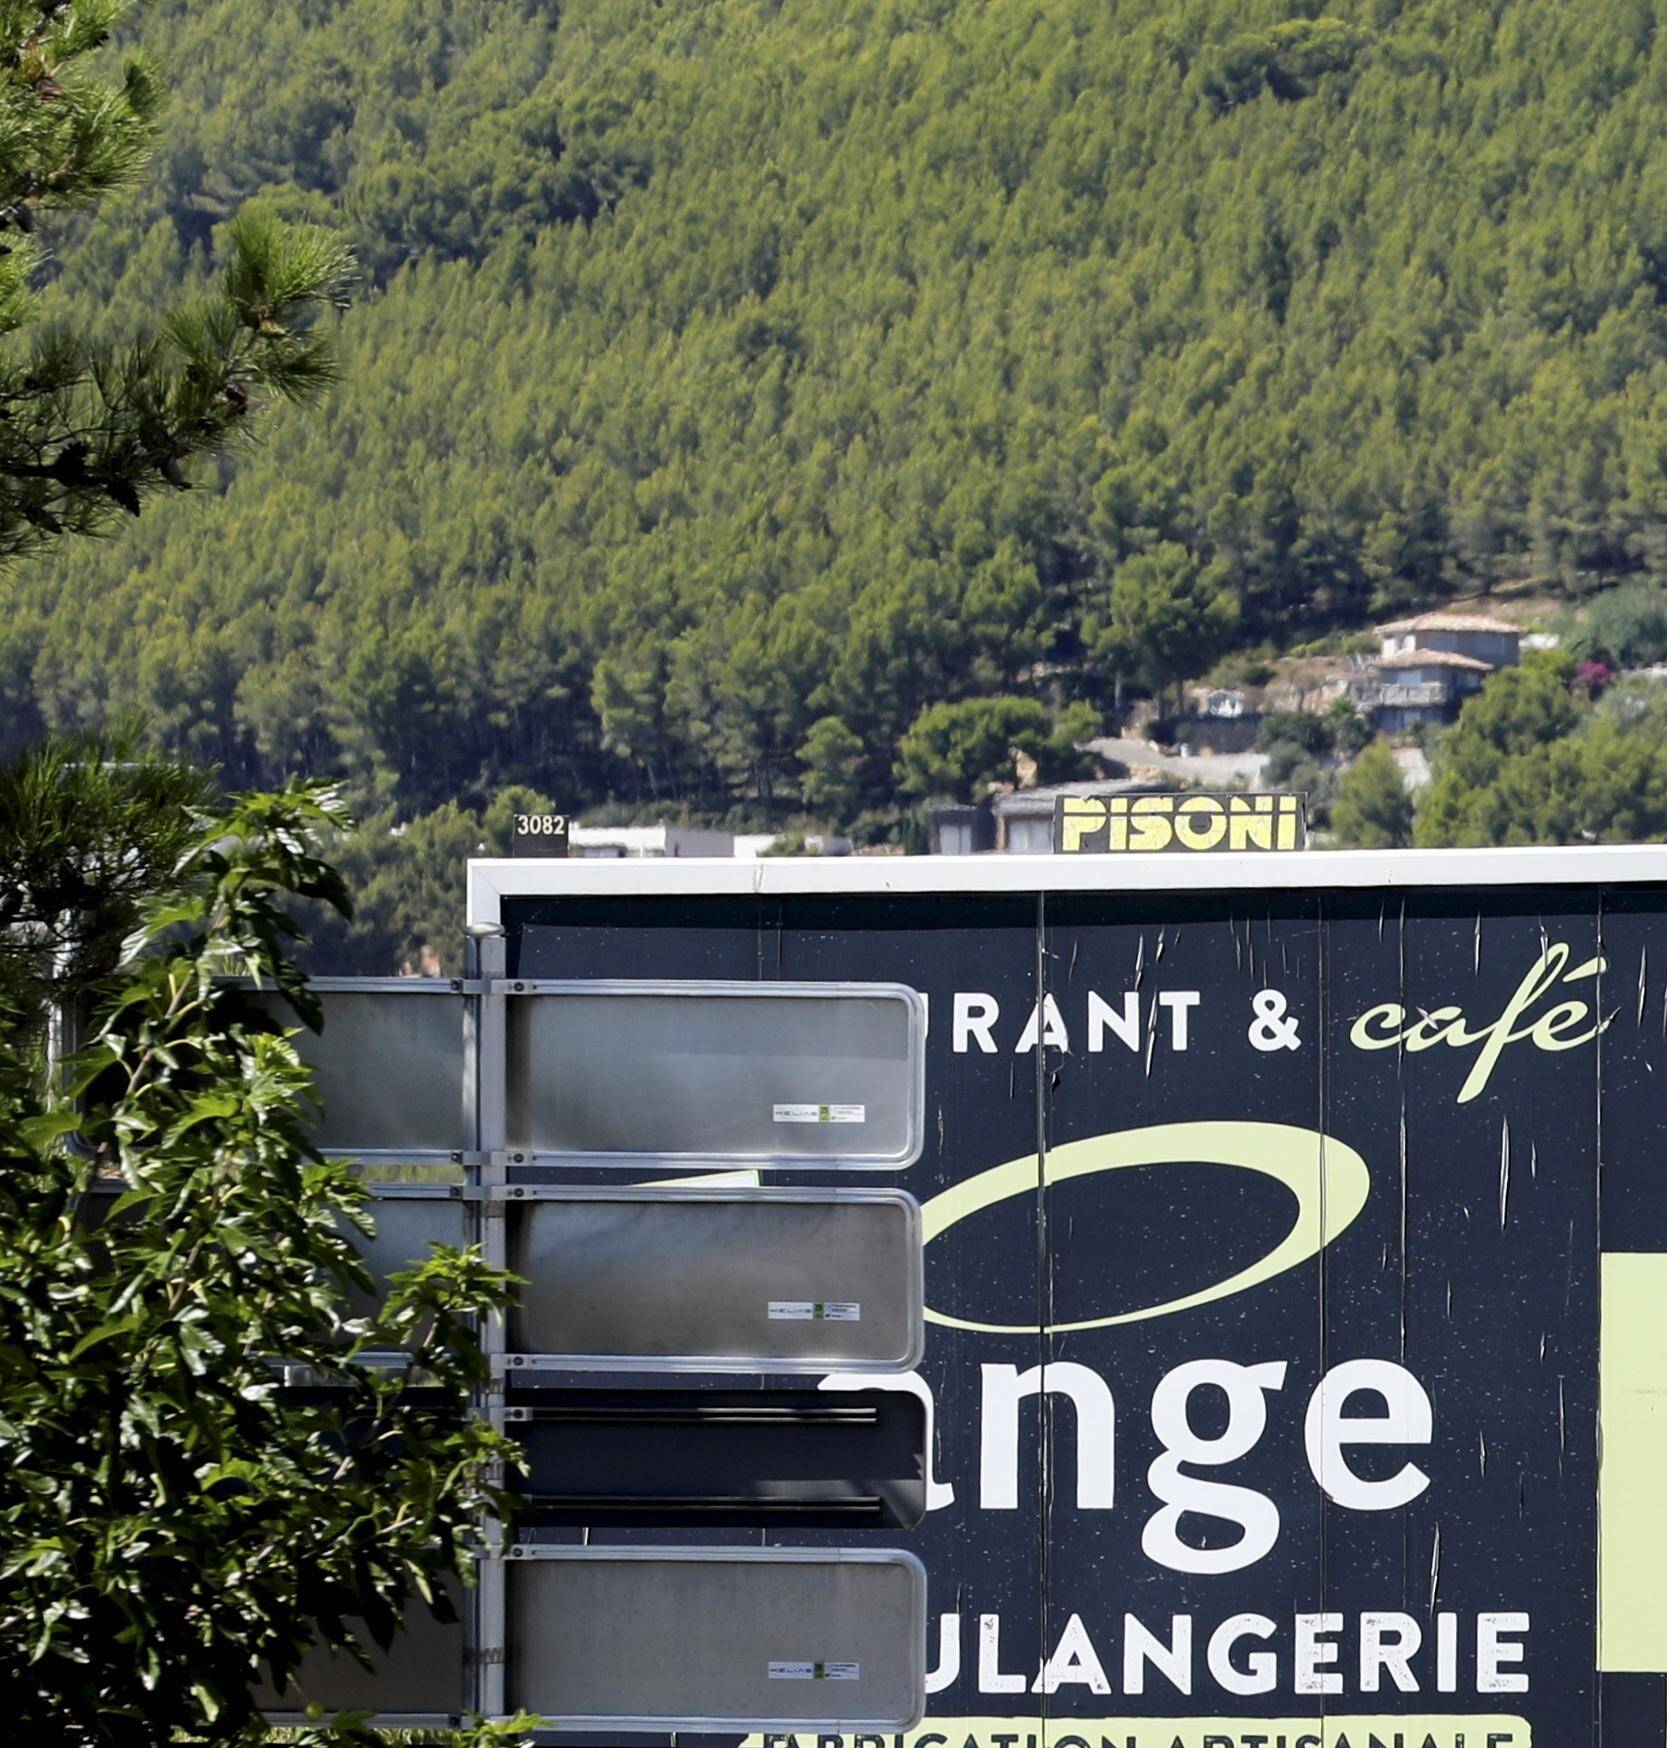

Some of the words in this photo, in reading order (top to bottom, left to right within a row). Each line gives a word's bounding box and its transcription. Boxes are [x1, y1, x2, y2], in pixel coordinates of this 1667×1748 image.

[516, 814, 566, 836] 3082
[1062, 796, 1297, 851] PISONI
[924, 992, 1202, 1054] RANT
[1248, 989, 1300, 1052] &
[1350, 942, 1607, 1104] café
